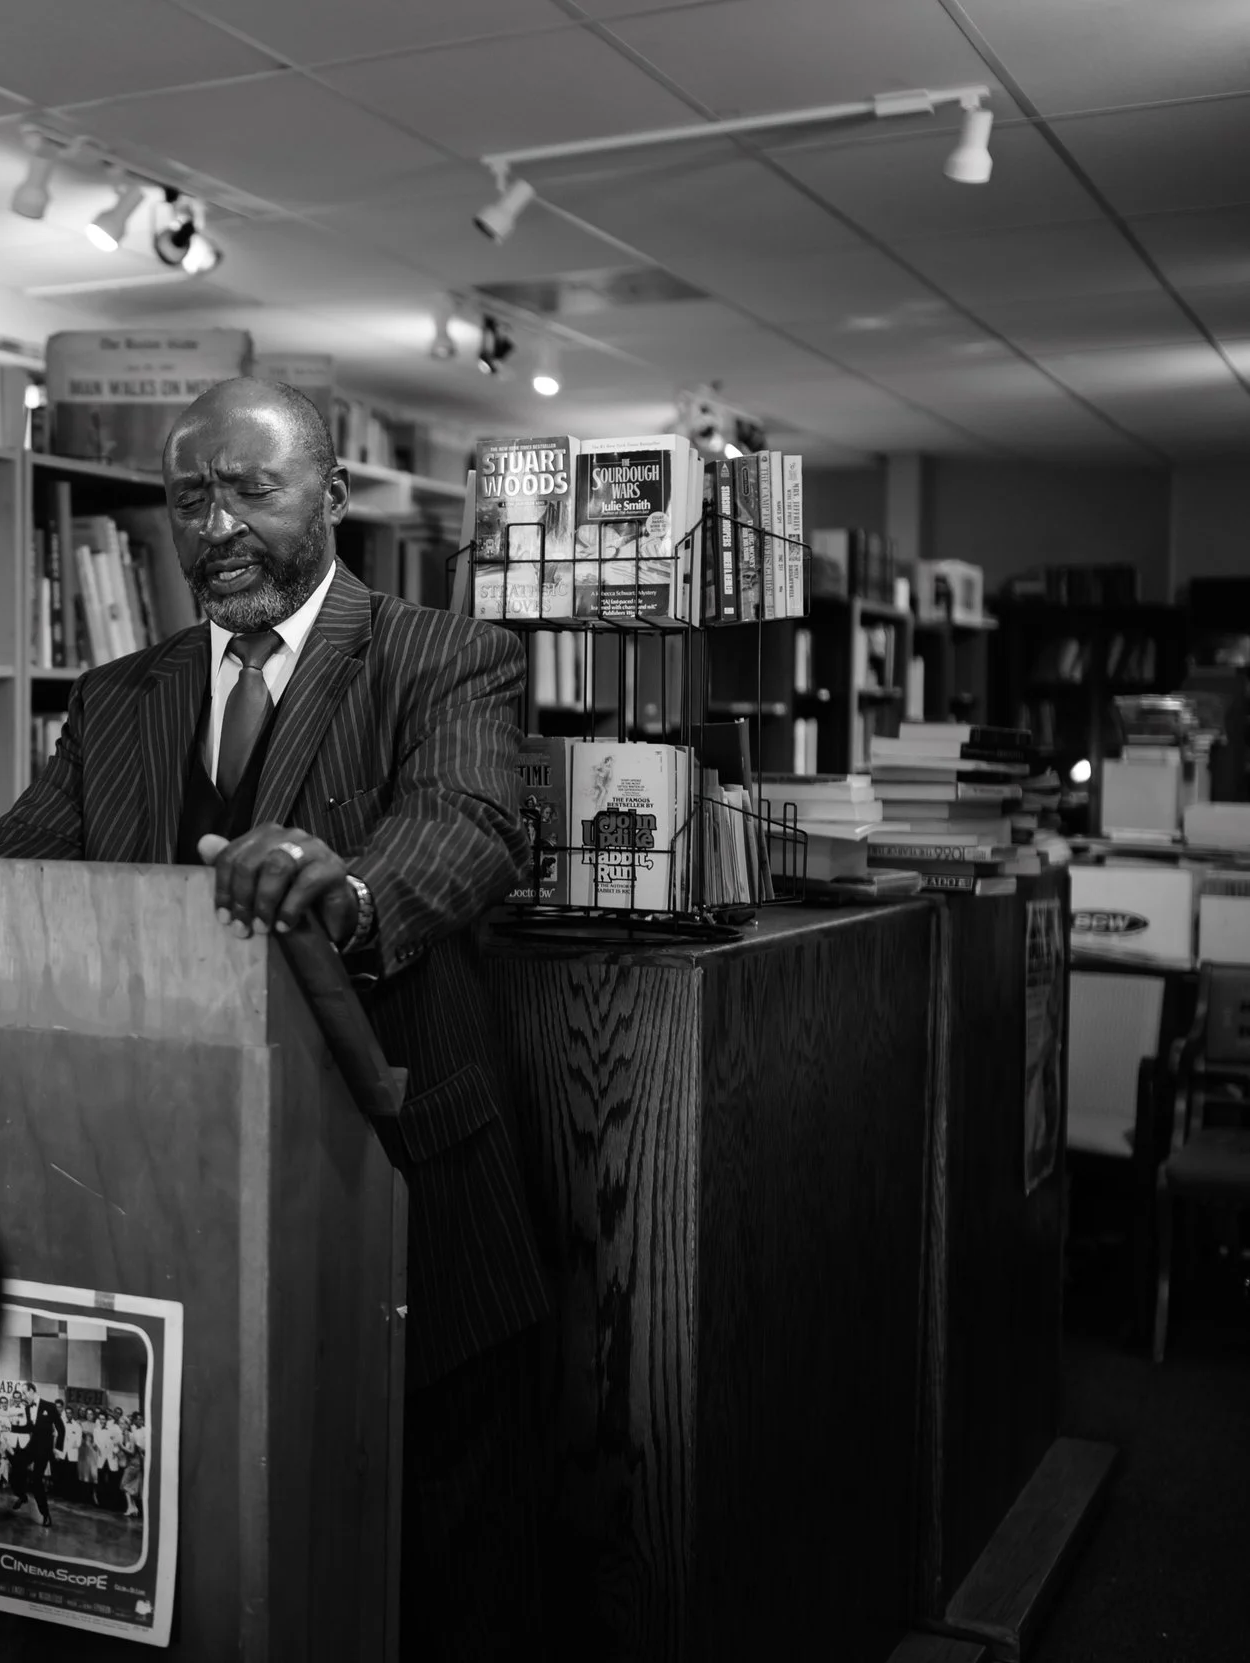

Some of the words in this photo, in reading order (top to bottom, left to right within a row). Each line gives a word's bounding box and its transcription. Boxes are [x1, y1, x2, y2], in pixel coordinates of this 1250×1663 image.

[481, 449, 567, 476] STUART
[482, 472, 569, 498] WOODS
[592, 464, 660, 491] SOURDOUGH
[611, 482, 641, 499] WARS
[602, 500, 623, 513] Julie
[623, 499, 651, 511] Smith
[721, 485, 731, 516] STARSHIP
[722, 519, 731, 547] ROOPERS
[515, 764, 552, 787] TIME
[593, 864, 637, 883] Run
